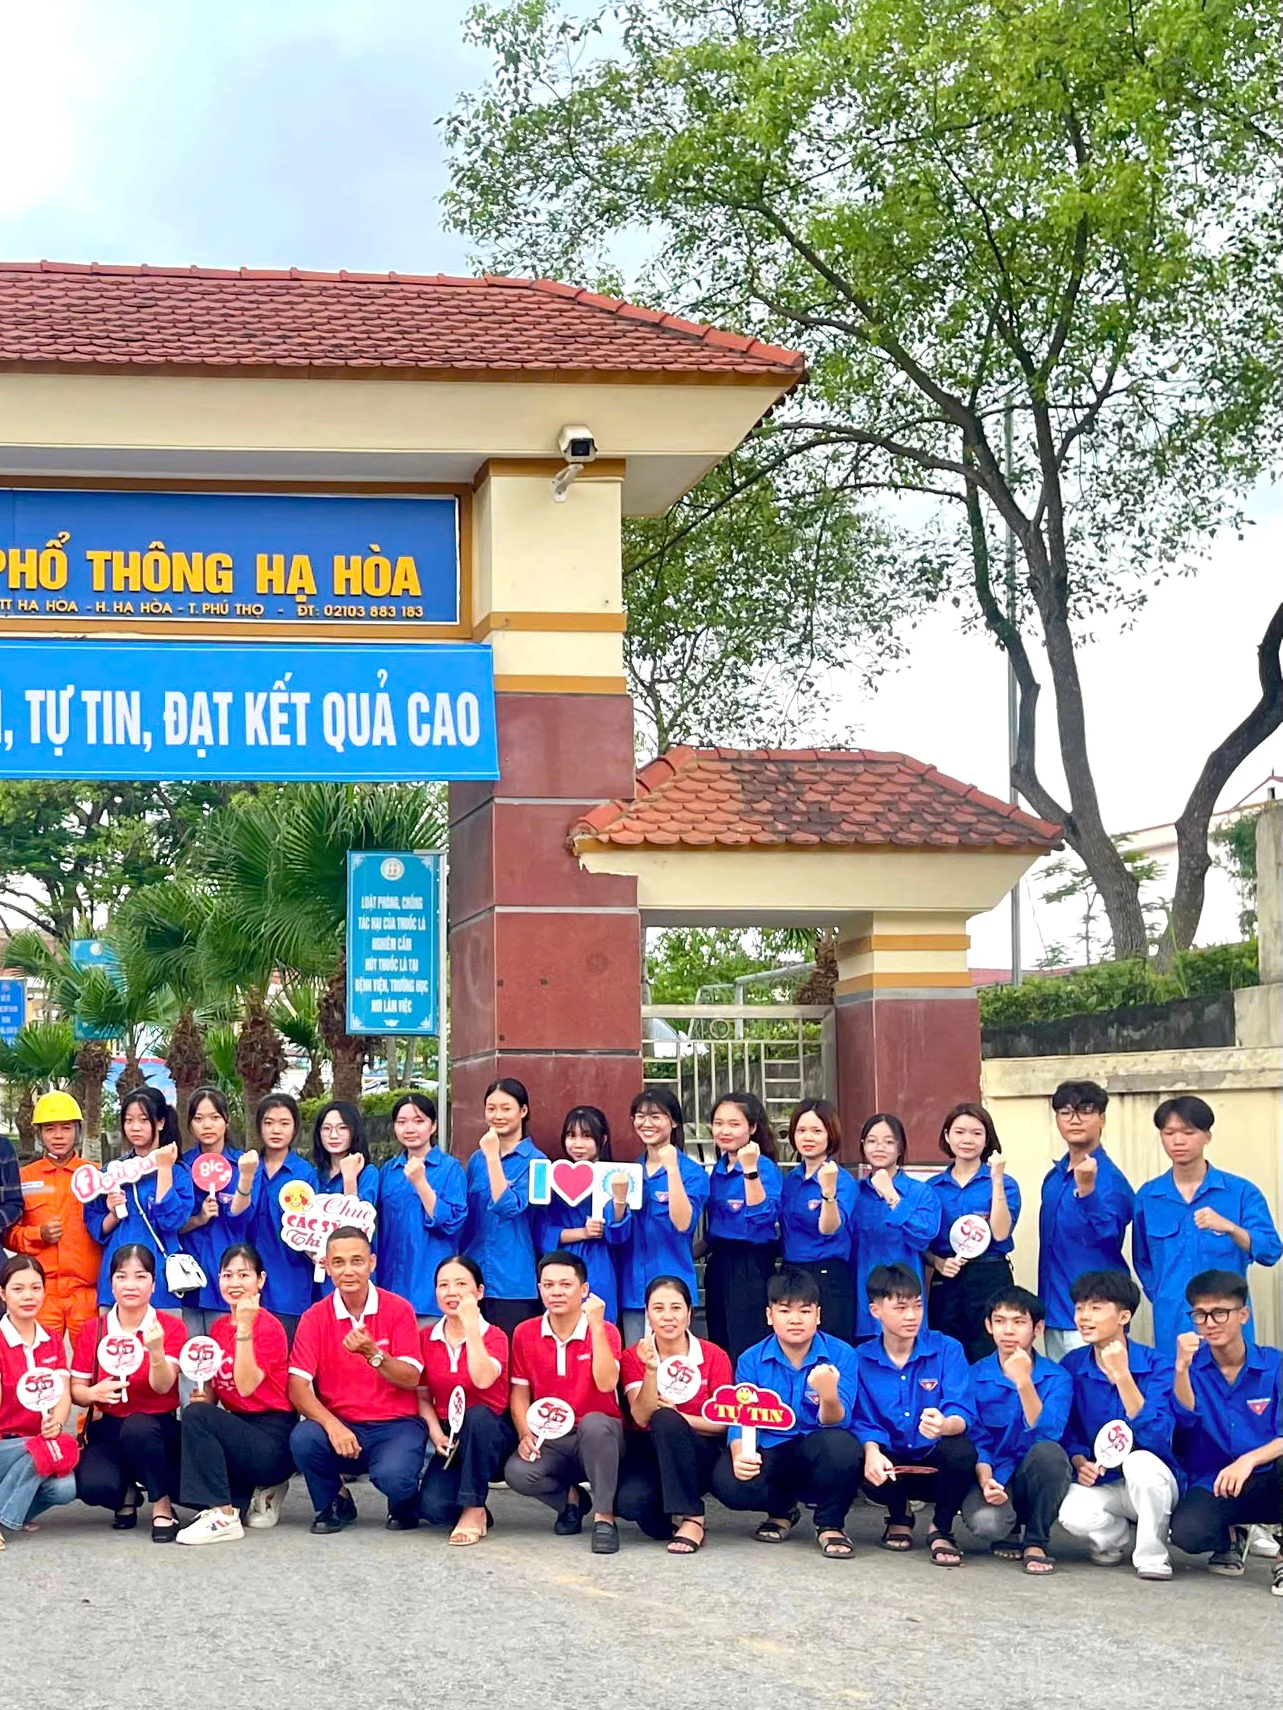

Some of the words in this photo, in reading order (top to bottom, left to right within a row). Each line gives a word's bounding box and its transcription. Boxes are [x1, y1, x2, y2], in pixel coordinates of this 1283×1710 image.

[86, 541, 234, 594] THÔNG
[258, 554, 317, 603] HẠ
[334, 544, 422, 597] HÒA
[0, 598, 12, 610] TT
[18, 600, 40, 614] HẠ
[46, 597, 78, 612] HÒA
[95, 601, 110, 613] H.
[113, 602, 135, 615] HẠ
[140, 598, 173, 614] HÒA
[188, 602, 199, 615] T.
[202, 599, 229, 615] PHÚ
[235, 603, 265, 619] THỌ
[324, 604, 366, 618] 02103
[401, 605, 424, 618] 183
[25, 685, 75, 757] TỰ
[82, 691, 153, 753] TIN,
[164, 692, 234, 758] ĐẠT
[246, 672, 311, 746] KẾT
[323, 669, 397, 754] QUẢ
[408, 692, 480, 747] CAO
[534, 1163, 547, 1199] I
[714, 1404, 743, 1423] TỰ
[747, 1406, 784, 1423] TIN
